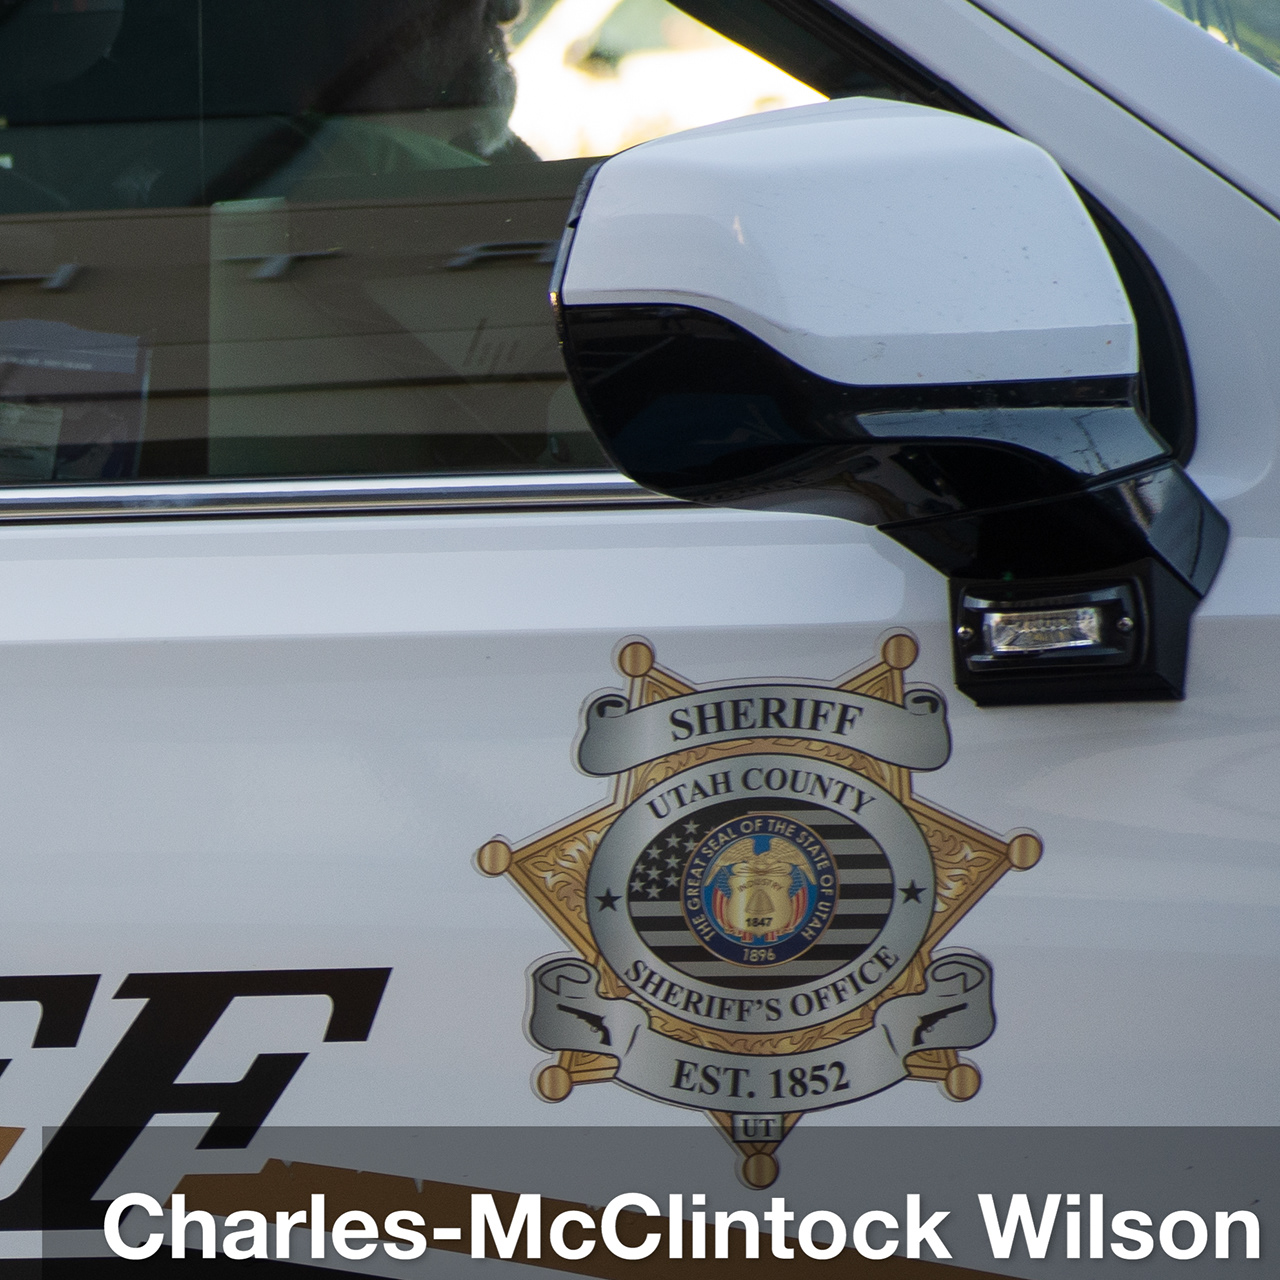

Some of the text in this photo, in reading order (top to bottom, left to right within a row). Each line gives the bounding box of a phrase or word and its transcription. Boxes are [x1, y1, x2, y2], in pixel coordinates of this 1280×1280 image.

[669, 697, 864, 741] SHERIFF
[645, 767, 877, 821] UTAH COUNTY
[687, 819, 834, 942] THE GREAT SEAL OF THE STATE OF UTAH
[745, 917, 774, 927] 1847
[743, 949, 776, 962] 1896
[624, 945, 900, 1022] SHERIFF'S OFFICE
[669, 1058, 851, 1099] EST. 1852
[741, 1119, 775, 1138] UT
